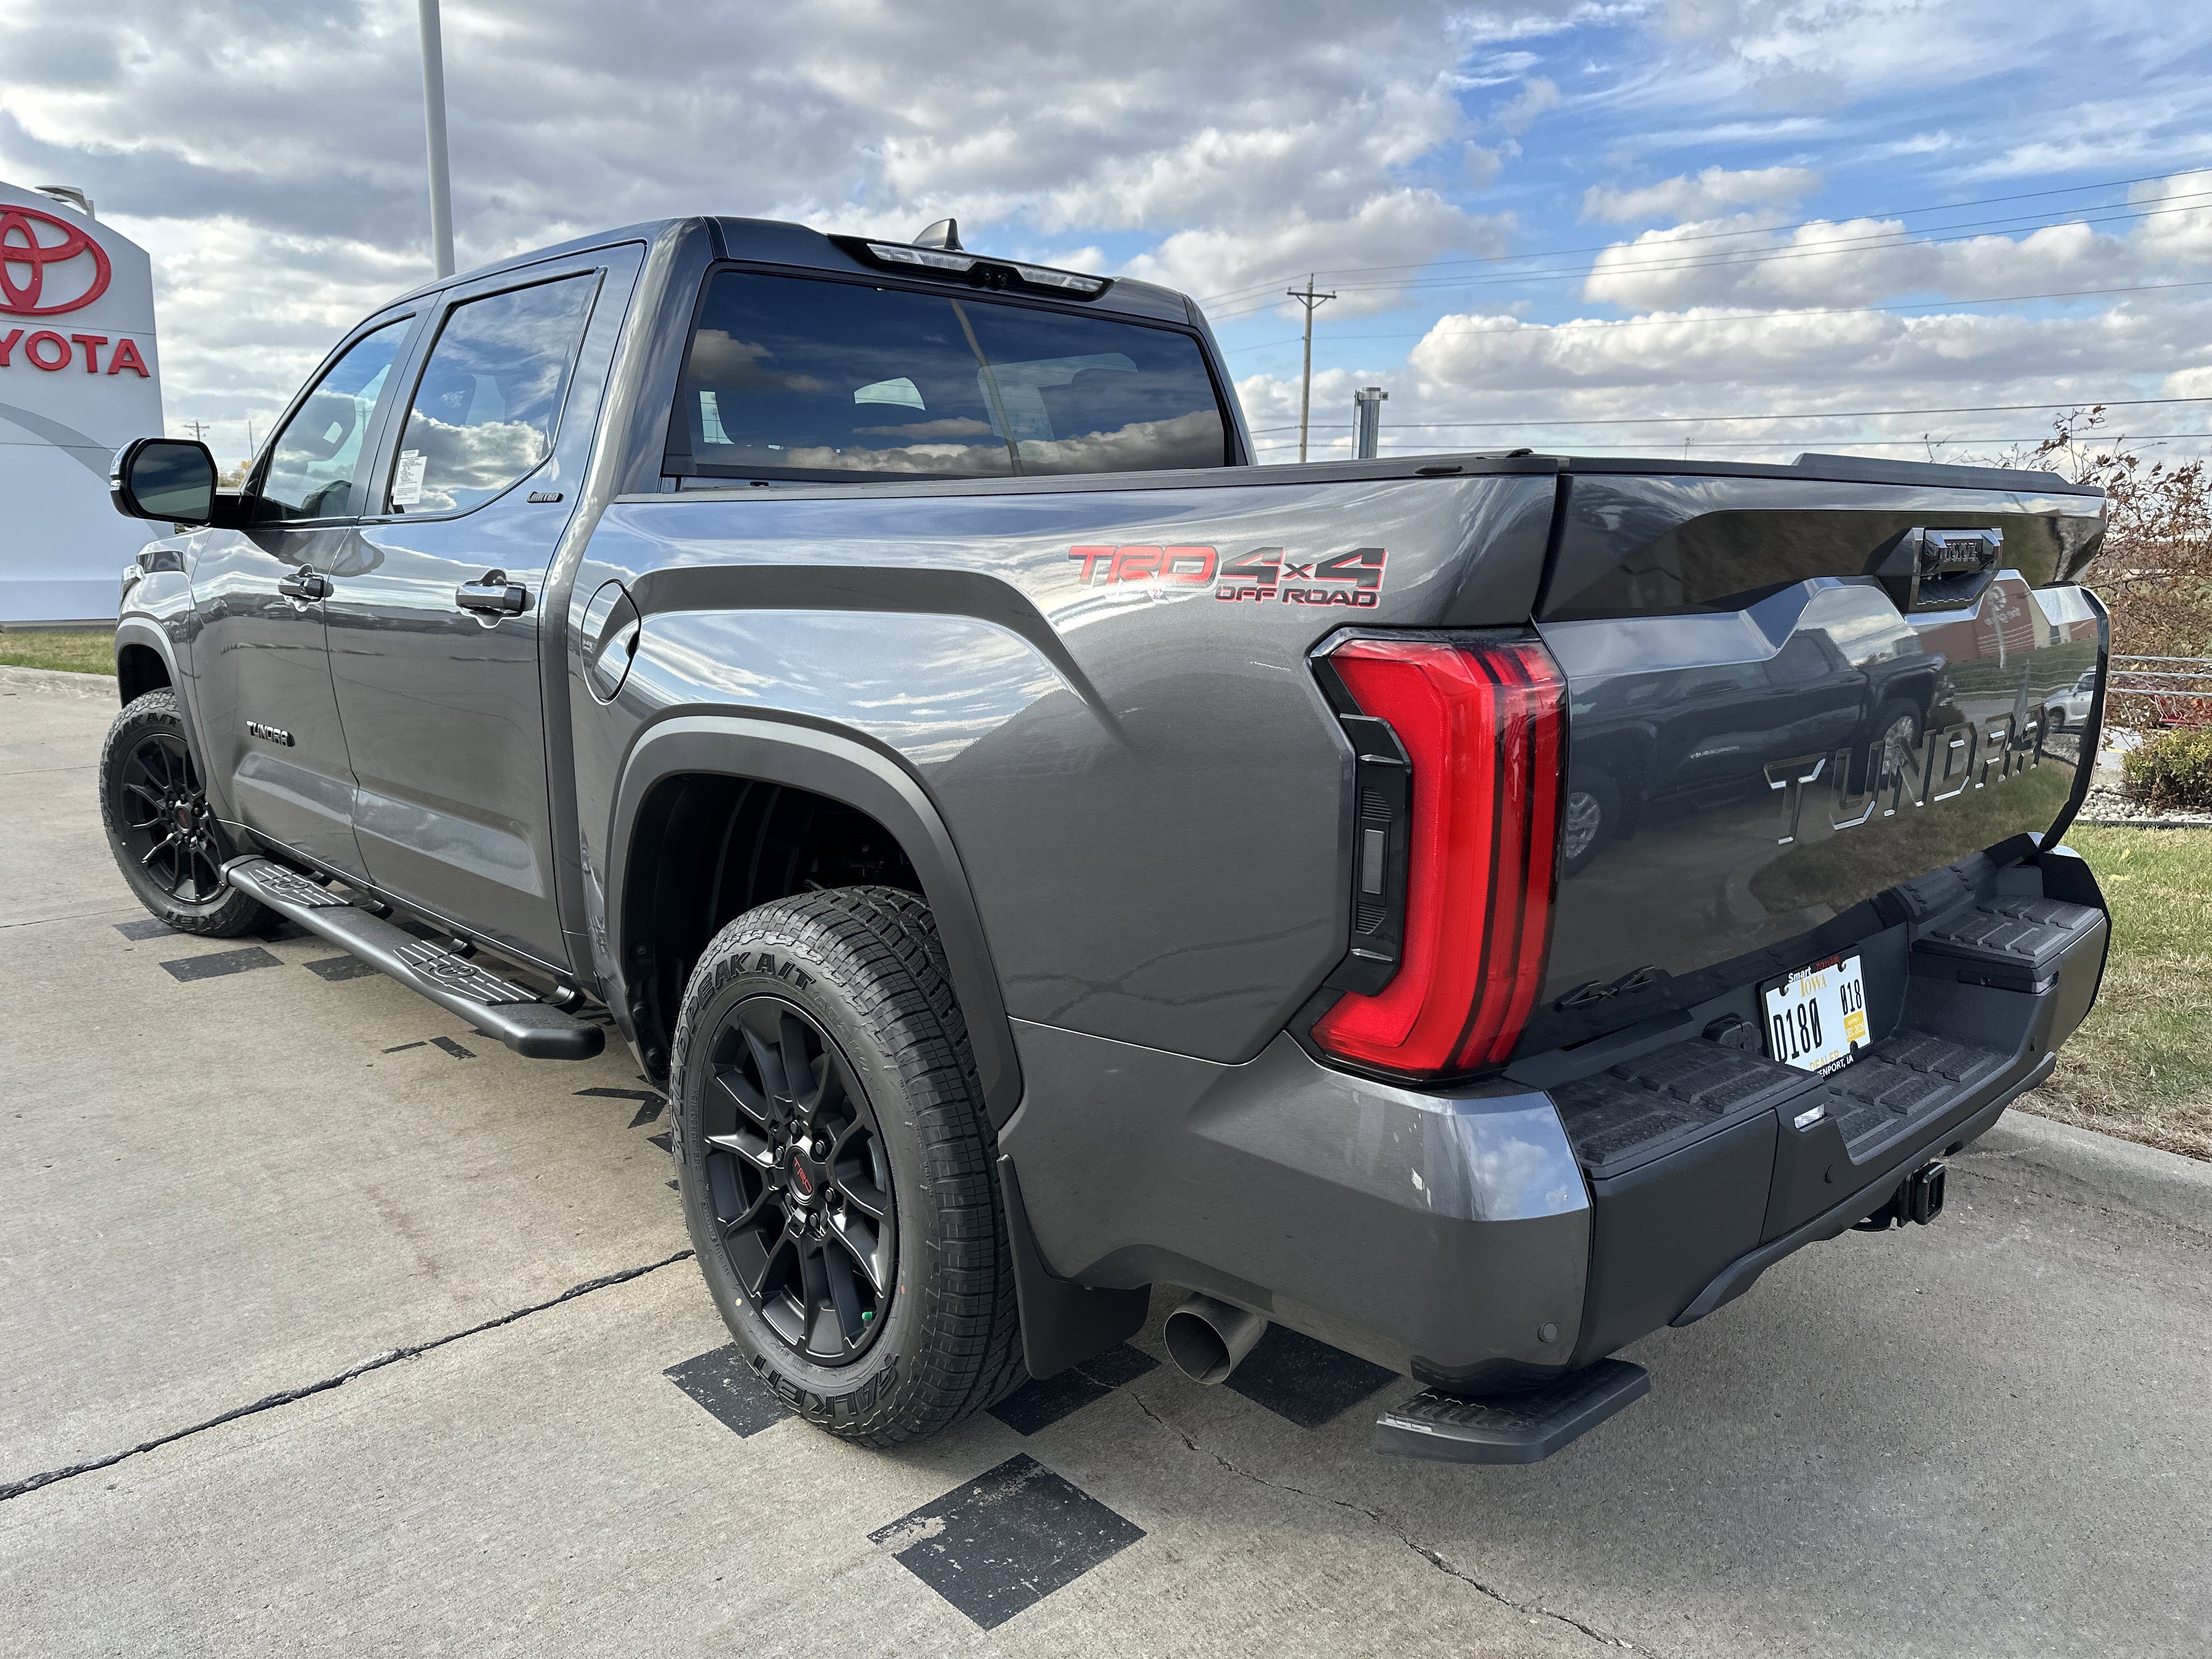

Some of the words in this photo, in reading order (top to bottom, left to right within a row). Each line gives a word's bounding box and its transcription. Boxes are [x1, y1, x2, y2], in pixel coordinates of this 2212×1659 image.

[1069, 545, 1220, 593] TRD
[1216, 586, 1277, 604] OFF
[1282, 589, 1380, 610] ROAD
[246, 720, 295, 747] TUNDRA
[1764, 703, 2046, 845] TUNDRA
[1788, 966, 1812, 983] Smart
[1840, 979, 1862, 1016] 018
[1773, 997, 1822, 1064] D180
[1847, 1054, 1854, 1065] IA
[793, 1156, 813, 1194] TRD
[753, 1352, 899, 1418] FALKEN
